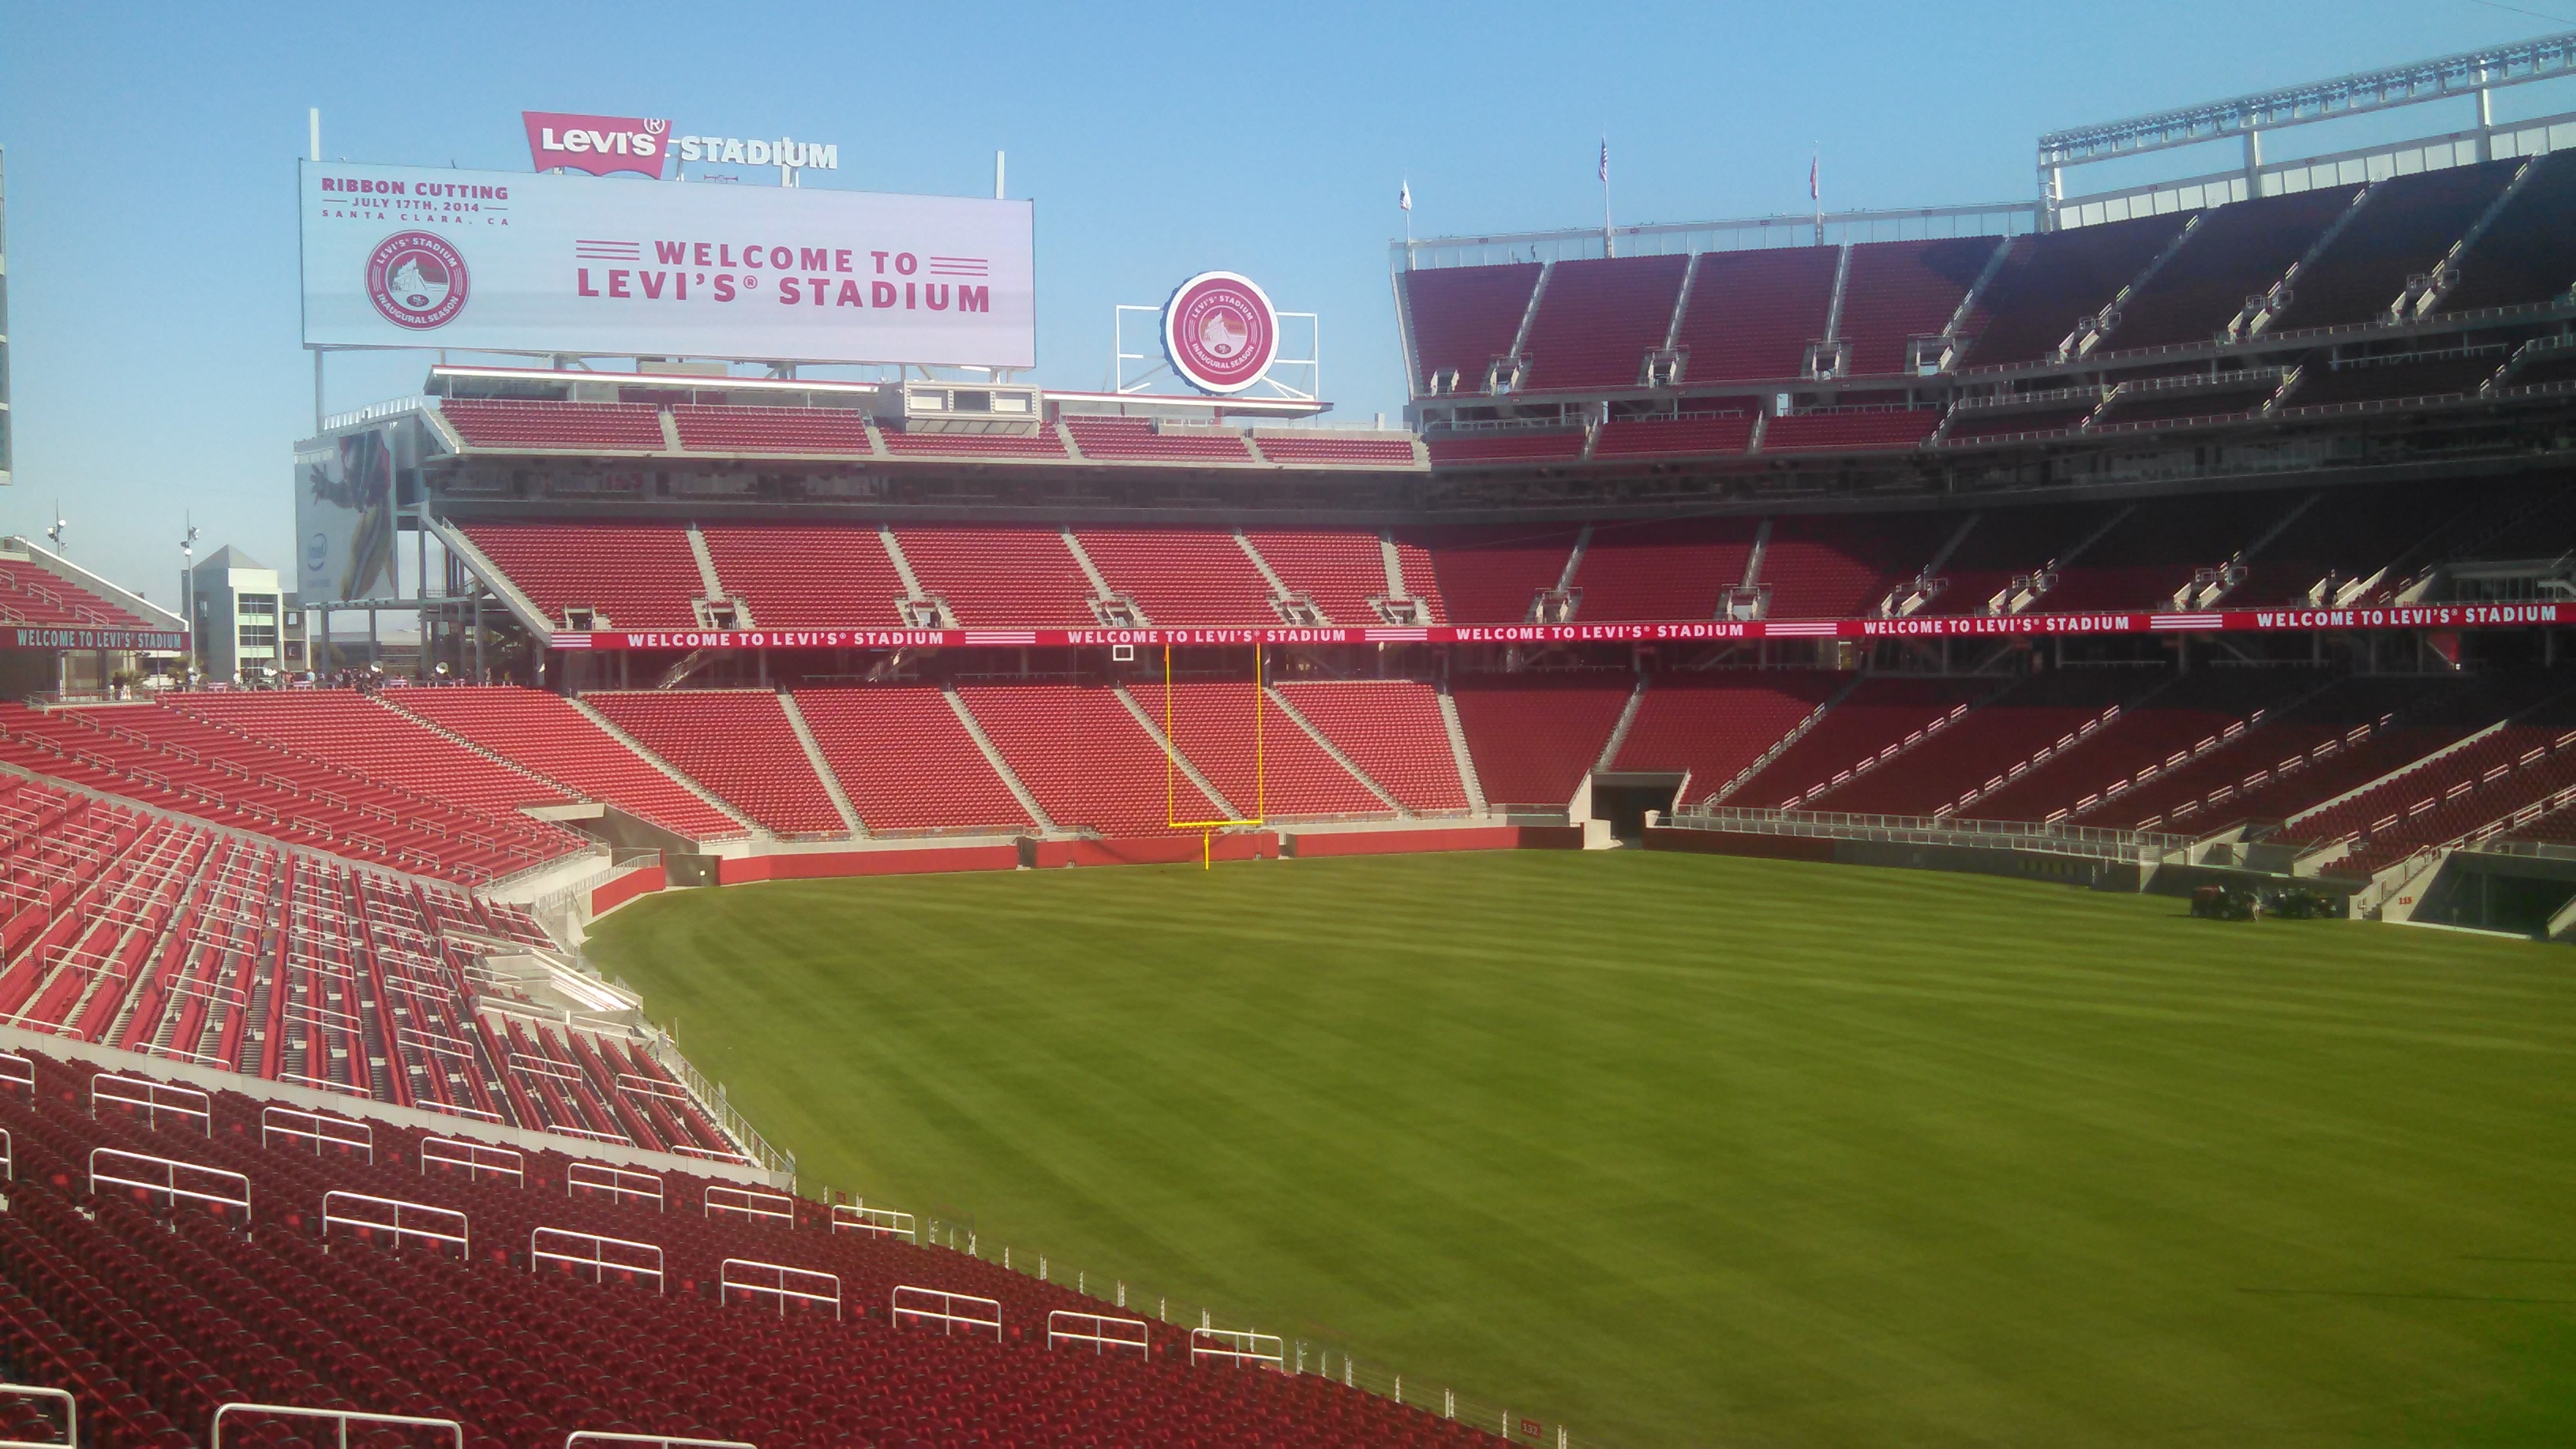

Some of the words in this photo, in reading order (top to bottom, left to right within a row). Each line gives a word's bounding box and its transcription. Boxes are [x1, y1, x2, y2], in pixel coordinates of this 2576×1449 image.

[680, 136, 837, 169] STADIUM
[322, 178, 404, 194] RIBBON
[414, 182, 508, 200] CUTTING
[322, 210, 384, 219] SANTA
[353, 198, 389, 208] JULY
[396, 200, 437, 211] 17TH,
[444, 202, 478, 212] 2014
[412, 238, 458, 268] STADIUM
[654, 240, 853, 273] WELCOME
[871, 251, 917, 275] TO
[779, 277, 990, 313] STADIUM
[376, 293, 428, 324] INAUGURAL
[428, 296, 459, 323] SEASON
[1219, 295, 1253, 320] STADIUM
[1193, 343, 1230, 369] INAUGURAL
[1231, 346, 1255, 368] SEASON
[1864, 621, 1942, 634] WELCOME
[1949, 620, 1969, 632] TO
[2046, 616, 2129, 631] STADIUM
[2257, 613, 2353, 627] WELCOME
[2361, 612, 2383, 624] TO
[2466, 607, 2555, 623] STADIUM
[17, 630, 75, 646] WELCOME
[79, 631, 93, 647] TO
[138, 634, 181, 648] STADIUM
[628, 634, 729, 646] WELCOME
[739, 634, 764, 645] TO
[855, 632, 942, 644] STADIUM
[1068, 632, 1157, 642] WELCOME
[1166, 631, 1187, 642] TO
[1267, 630, 1345, 642] STADIUM
[1456, 627, 1544, 639] WELCOME
[1552, 627, 1574, 638] TO
[1658, 624, 1743, 637] STADIUM
